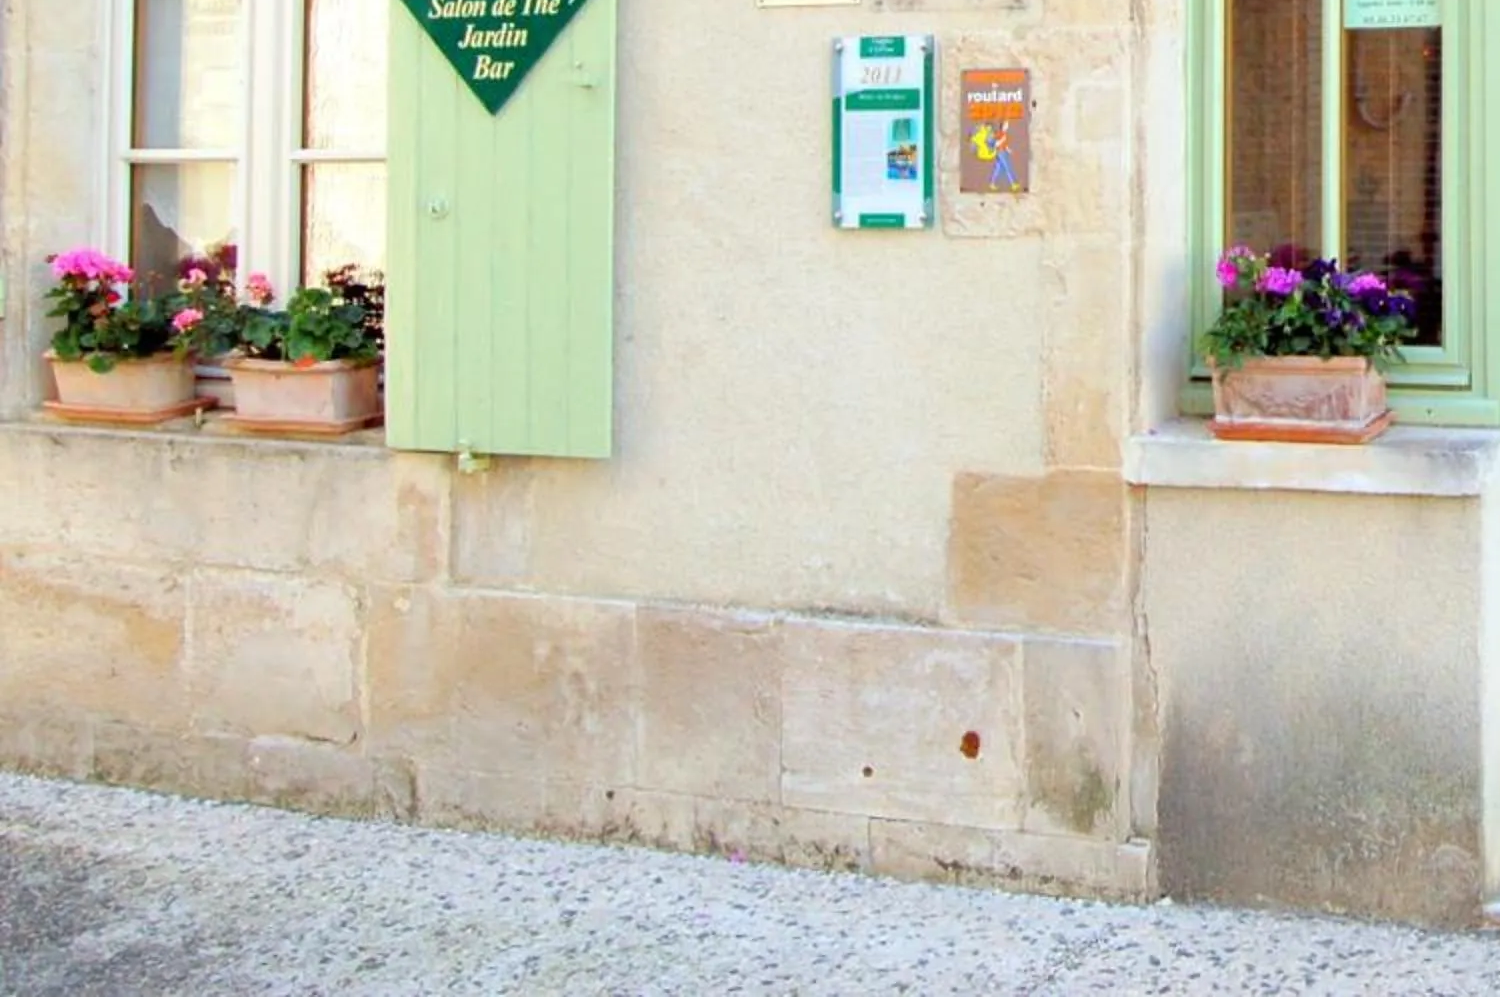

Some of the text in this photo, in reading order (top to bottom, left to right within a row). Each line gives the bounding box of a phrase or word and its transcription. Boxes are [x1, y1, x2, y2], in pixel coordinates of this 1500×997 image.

[457, 23, 528, 49] Jardin
[473, 54, 515, 80] Bar
[968, 88, 1022, 104] routard
